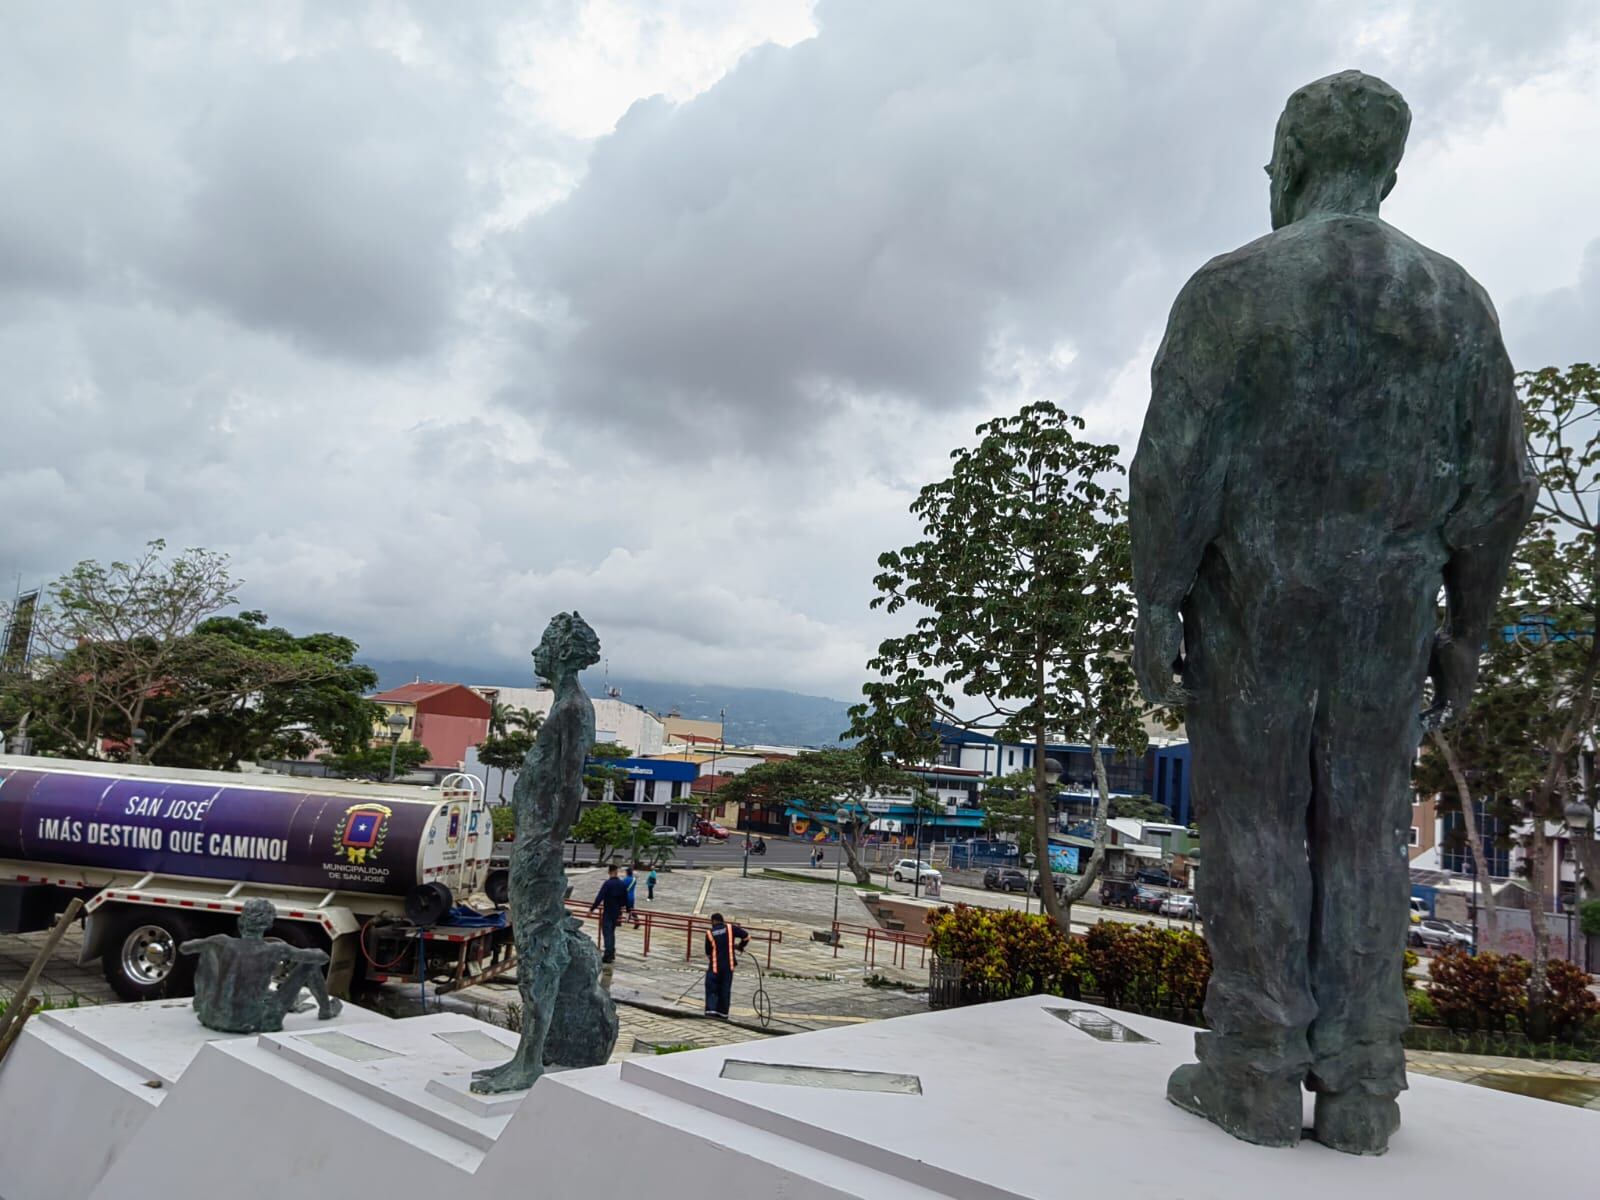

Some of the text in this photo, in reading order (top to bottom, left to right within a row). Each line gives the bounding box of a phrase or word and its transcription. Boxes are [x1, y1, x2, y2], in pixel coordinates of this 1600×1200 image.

[125, 796, 208, 821] SAN JOSÉ
[38, 816, 288, 861] ¡MÁS DESTINO QUE CAMINO!
[323, 863, 390, 875] MUNICIPALIDAD
[329, 872, 341, 880] DE
[343, 873, 361, 881] SAN
